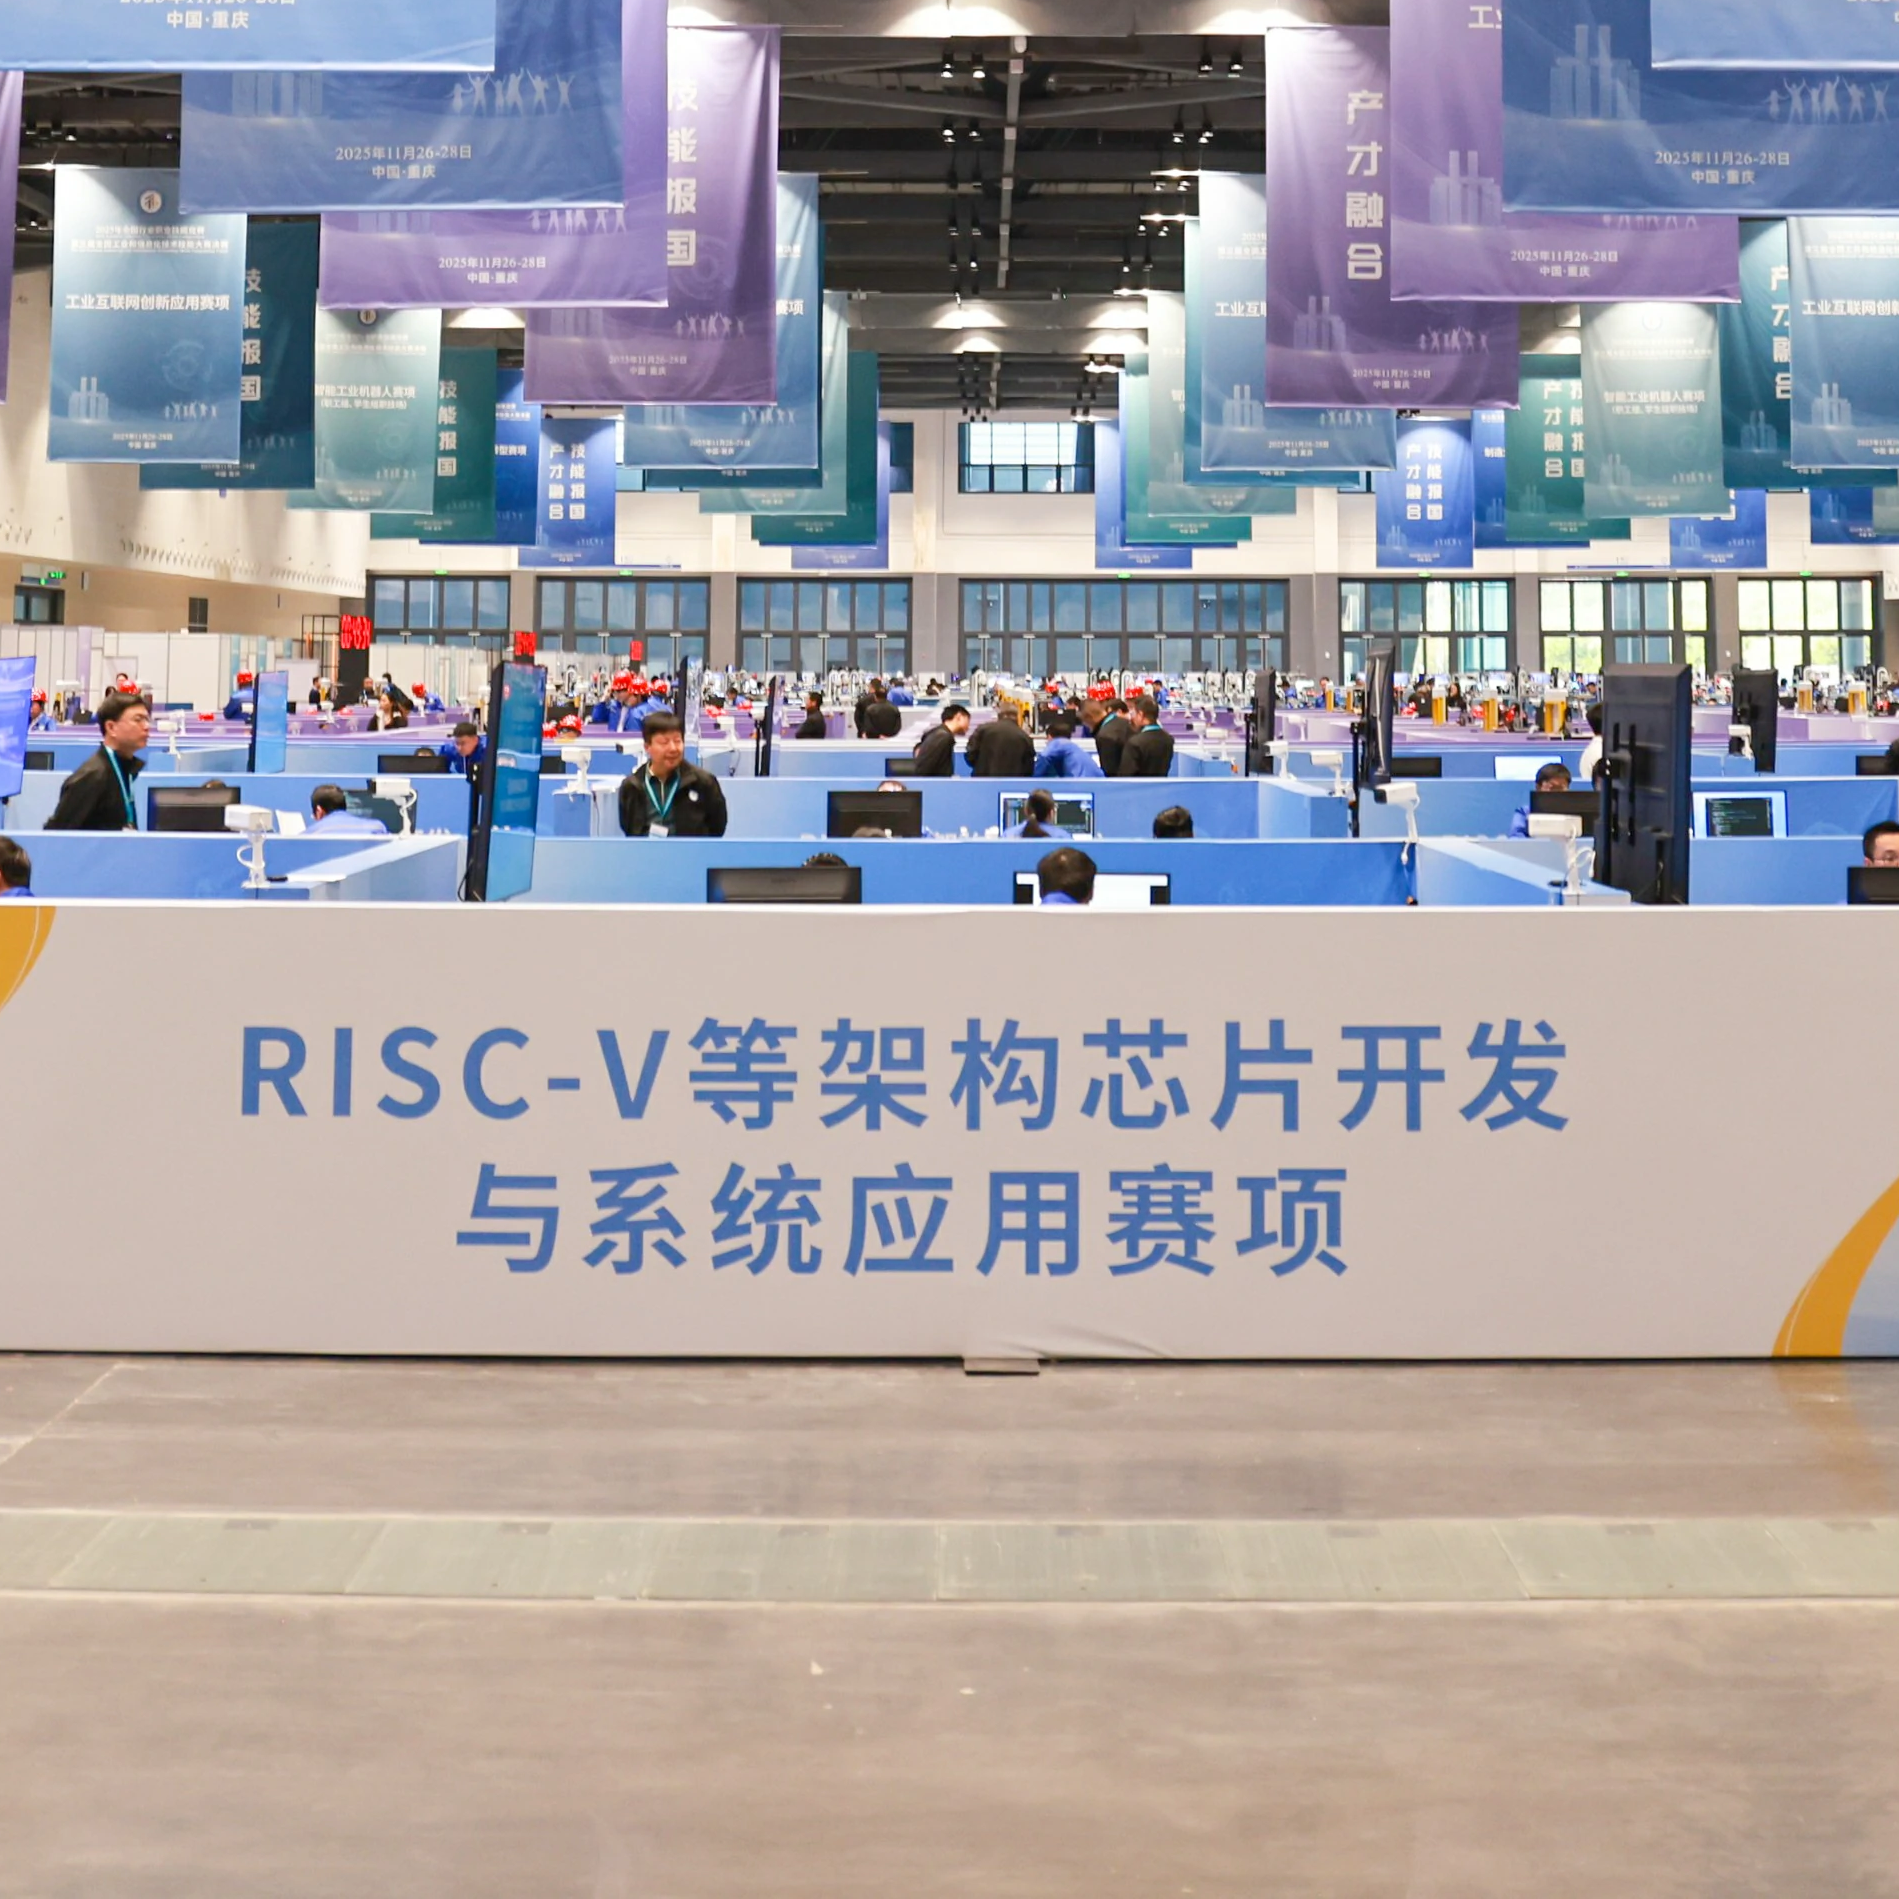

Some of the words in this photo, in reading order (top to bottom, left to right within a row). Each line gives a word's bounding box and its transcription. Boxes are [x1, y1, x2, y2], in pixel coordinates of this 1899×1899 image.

[167, 10, 250, 31] 中国·重庆
[335, 143, 472, 162] 2025年11月26-28日
[1655, 149, 1790, 168] 2025年11月26-28日
[1345, 89, 1385, 281] 产才融合
[438, 256, 547, 270] 2025年11月26-28日
[65, 293, 230, 311] 工业互联网创新应用赛项
[241, 1015, 1571, 1135] RISC-V等架构芯片开发
[454, 1160, 1352, 1278] 与系统应用赛项
